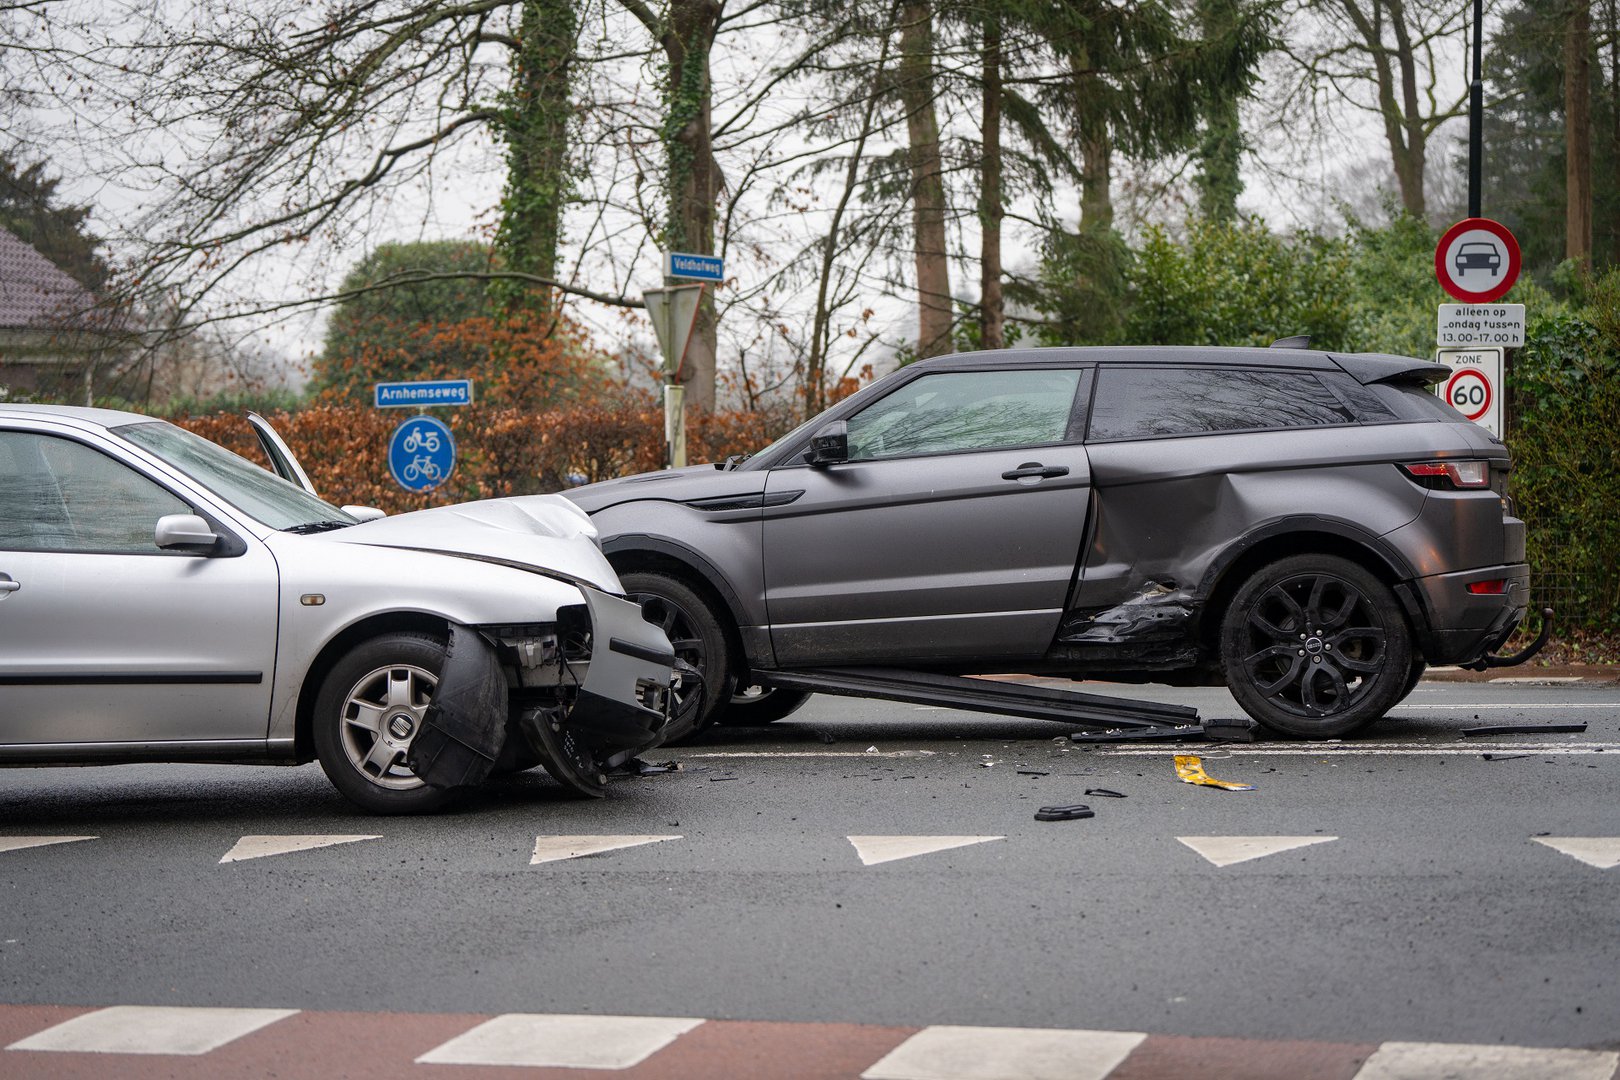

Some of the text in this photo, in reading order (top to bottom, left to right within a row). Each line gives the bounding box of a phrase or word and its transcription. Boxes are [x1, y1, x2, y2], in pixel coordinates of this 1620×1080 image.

[1456, 307, 1506, 317] alleen op
[1443, 320, 1480, 331] ondag
[1443, 333, 1519, 342] 13.00-17.00 h
[1455, 355, 1482, 364] ZONE
[381, 387, 465, 400] Arnhemseweg
[1453, 385, 1484, 405] 60
